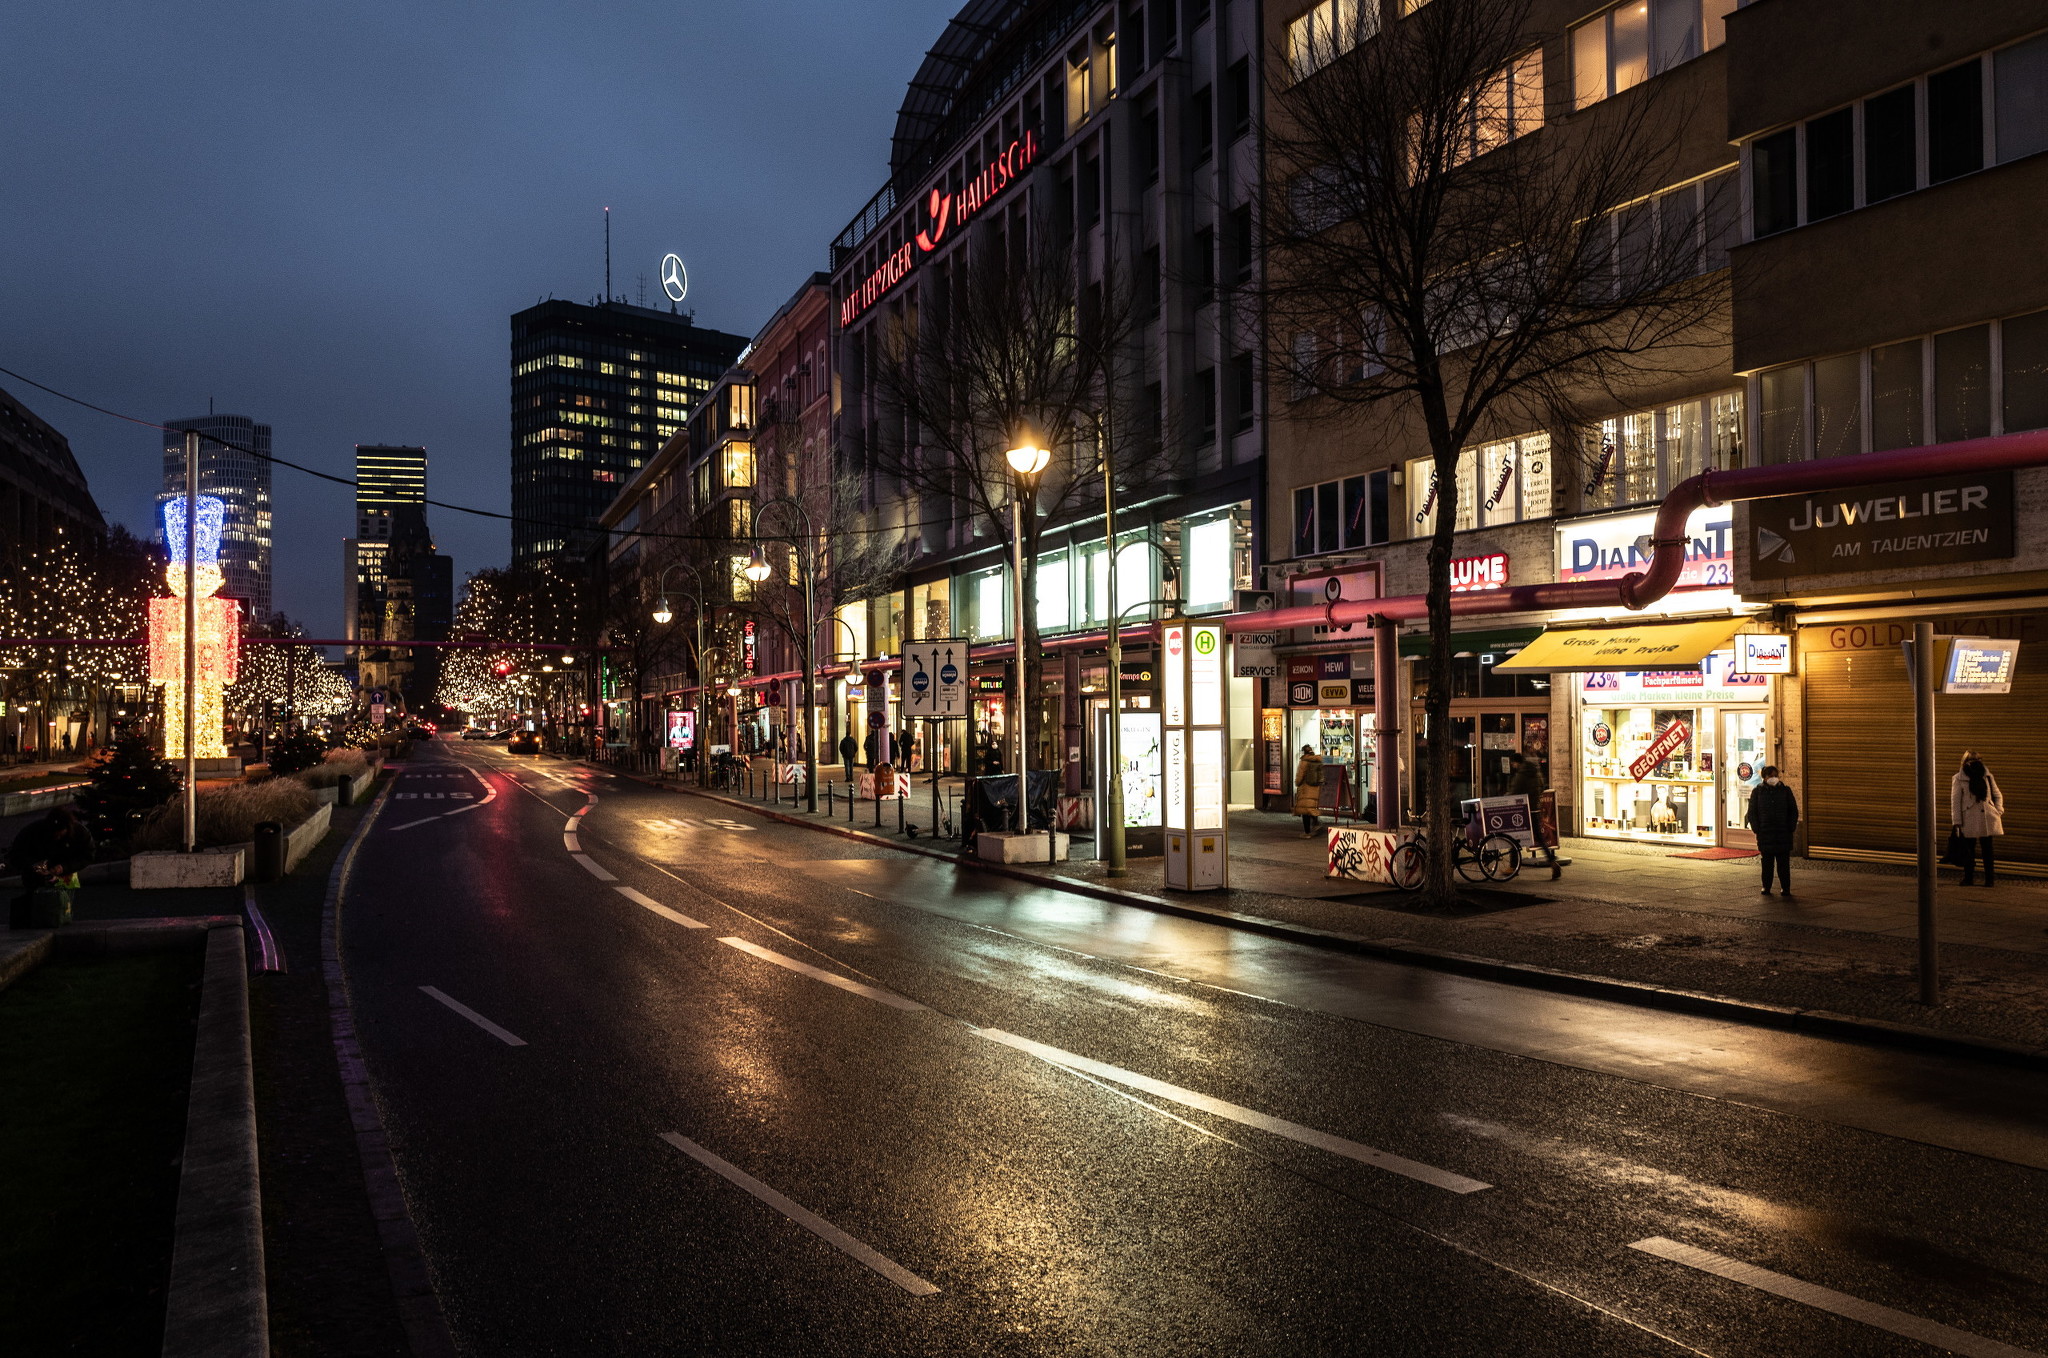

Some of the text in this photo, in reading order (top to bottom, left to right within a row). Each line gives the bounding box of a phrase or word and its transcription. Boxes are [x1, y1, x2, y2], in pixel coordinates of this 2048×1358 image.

[956, 129, 1037, 226] HALLESCH
[1485, 454, 1513, 512] DIAMANT
[1788, 485, 1989, 532] JUWELIER
[1573, 520, 1732, 574] DIAMNT
[1832, 528, 1989, 558] AM TAUENTZIEN
[1450, 556, 1504, 586] LUME
[1830, 616, 2036, 649] GOLDNKAUF
[1748, 643, 1788, 658] DIAMANT
[1240, 666, 1275, 677] SERVICE
[1324, 662, 1344, 673] HEWI
[1325, 686, 1344, 697] EVVA
[1639, 690, 1672, 700] Marken
[1674, 689, 1703, 700] kleine
[1705, 690, 1735, 700] Preise
[1633, 725, 1686, 778] GEÖFFNET
[395, 792, 474, 800] BUS
[1203, 844, 1214, 852] BVG
